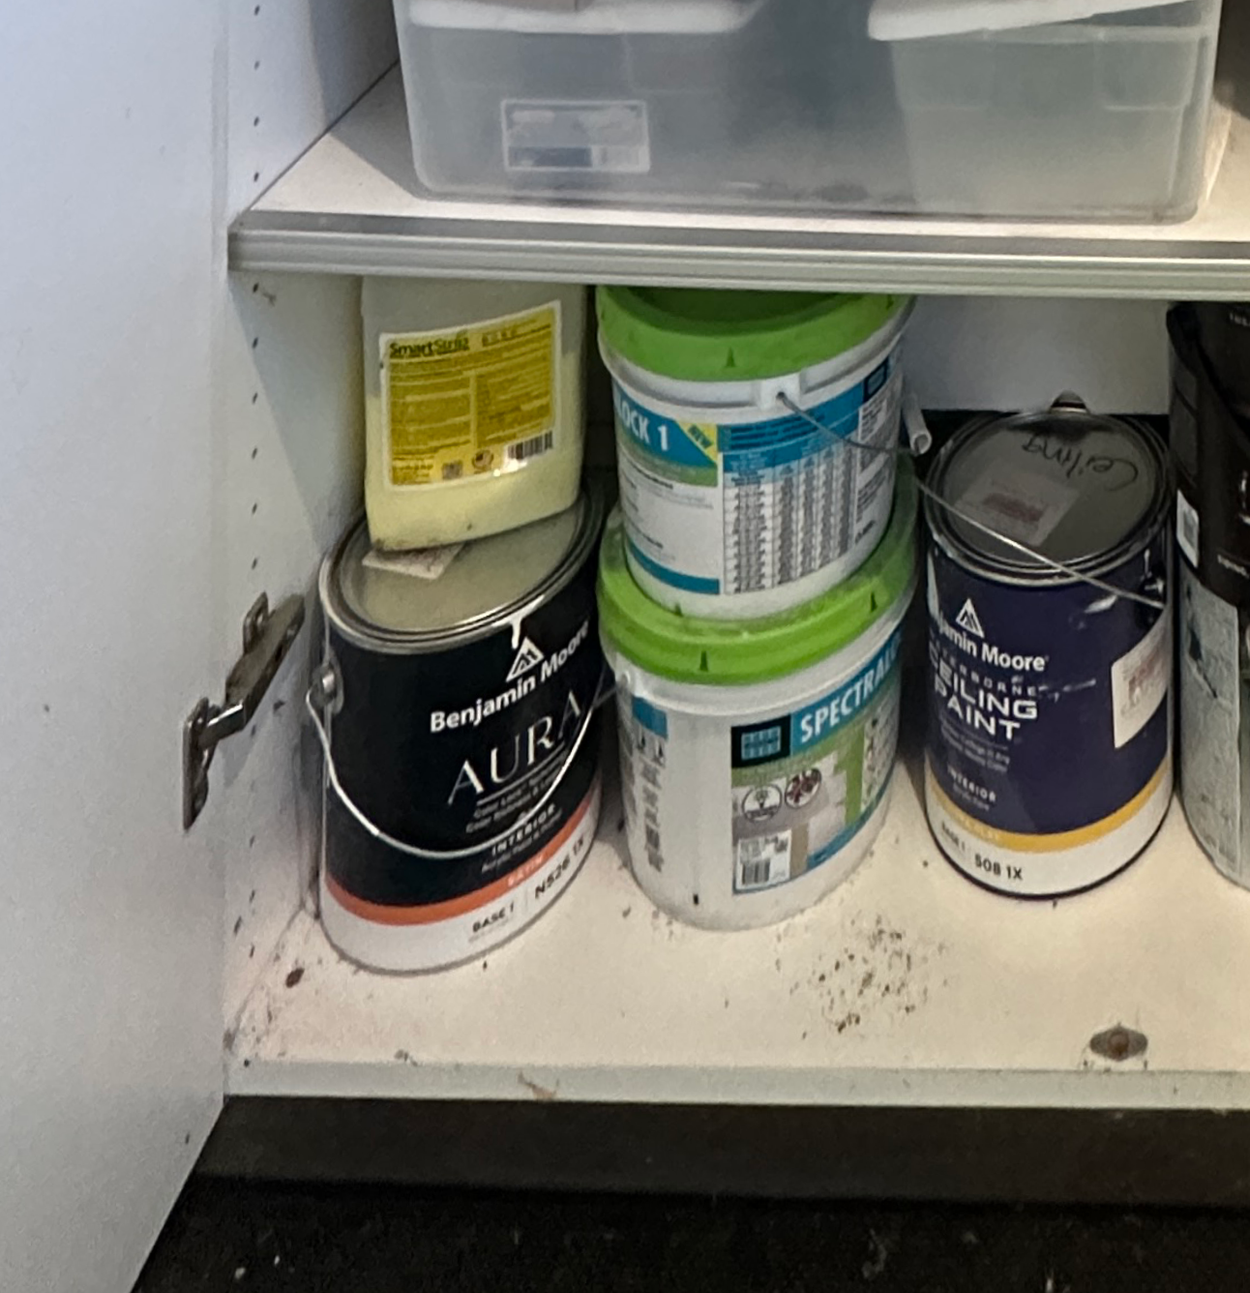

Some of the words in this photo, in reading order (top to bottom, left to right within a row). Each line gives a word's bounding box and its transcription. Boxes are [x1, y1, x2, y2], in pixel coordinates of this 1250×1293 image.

[981, 642, 1047, 672] Moore
[429, 673, 537, 734] Benjamin
[934, 671, 1021, 741] PAINT
[447, 688, 582, 806] AURA
[472, 905, 510, 933] BASE
